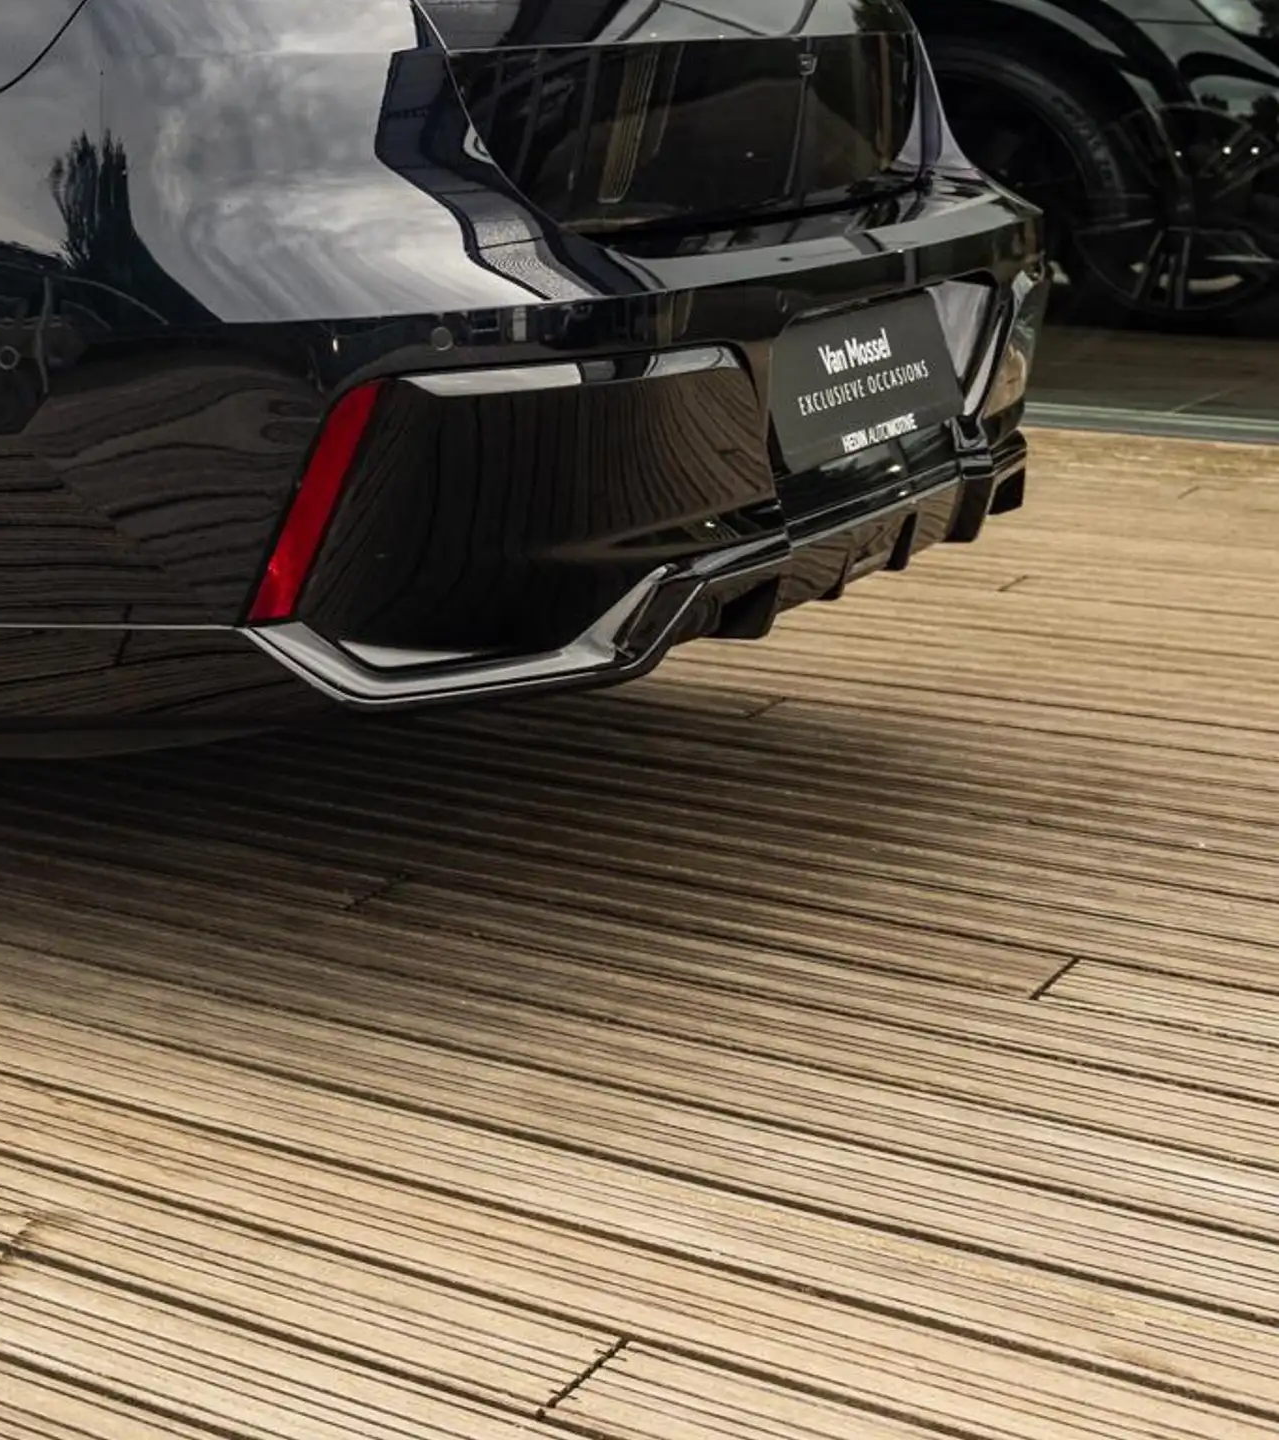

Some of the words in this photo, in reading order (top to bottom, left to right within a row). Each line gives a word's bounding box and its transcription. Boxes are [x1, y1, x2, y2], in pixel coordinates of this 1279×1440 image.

[817, 343, 848, 376] Van
[844, 327, 892, 368] Mossel
[796, 379, 867, 417] EXCLUSIEVE
[867, 358, 930, 394] OCCASIONS
